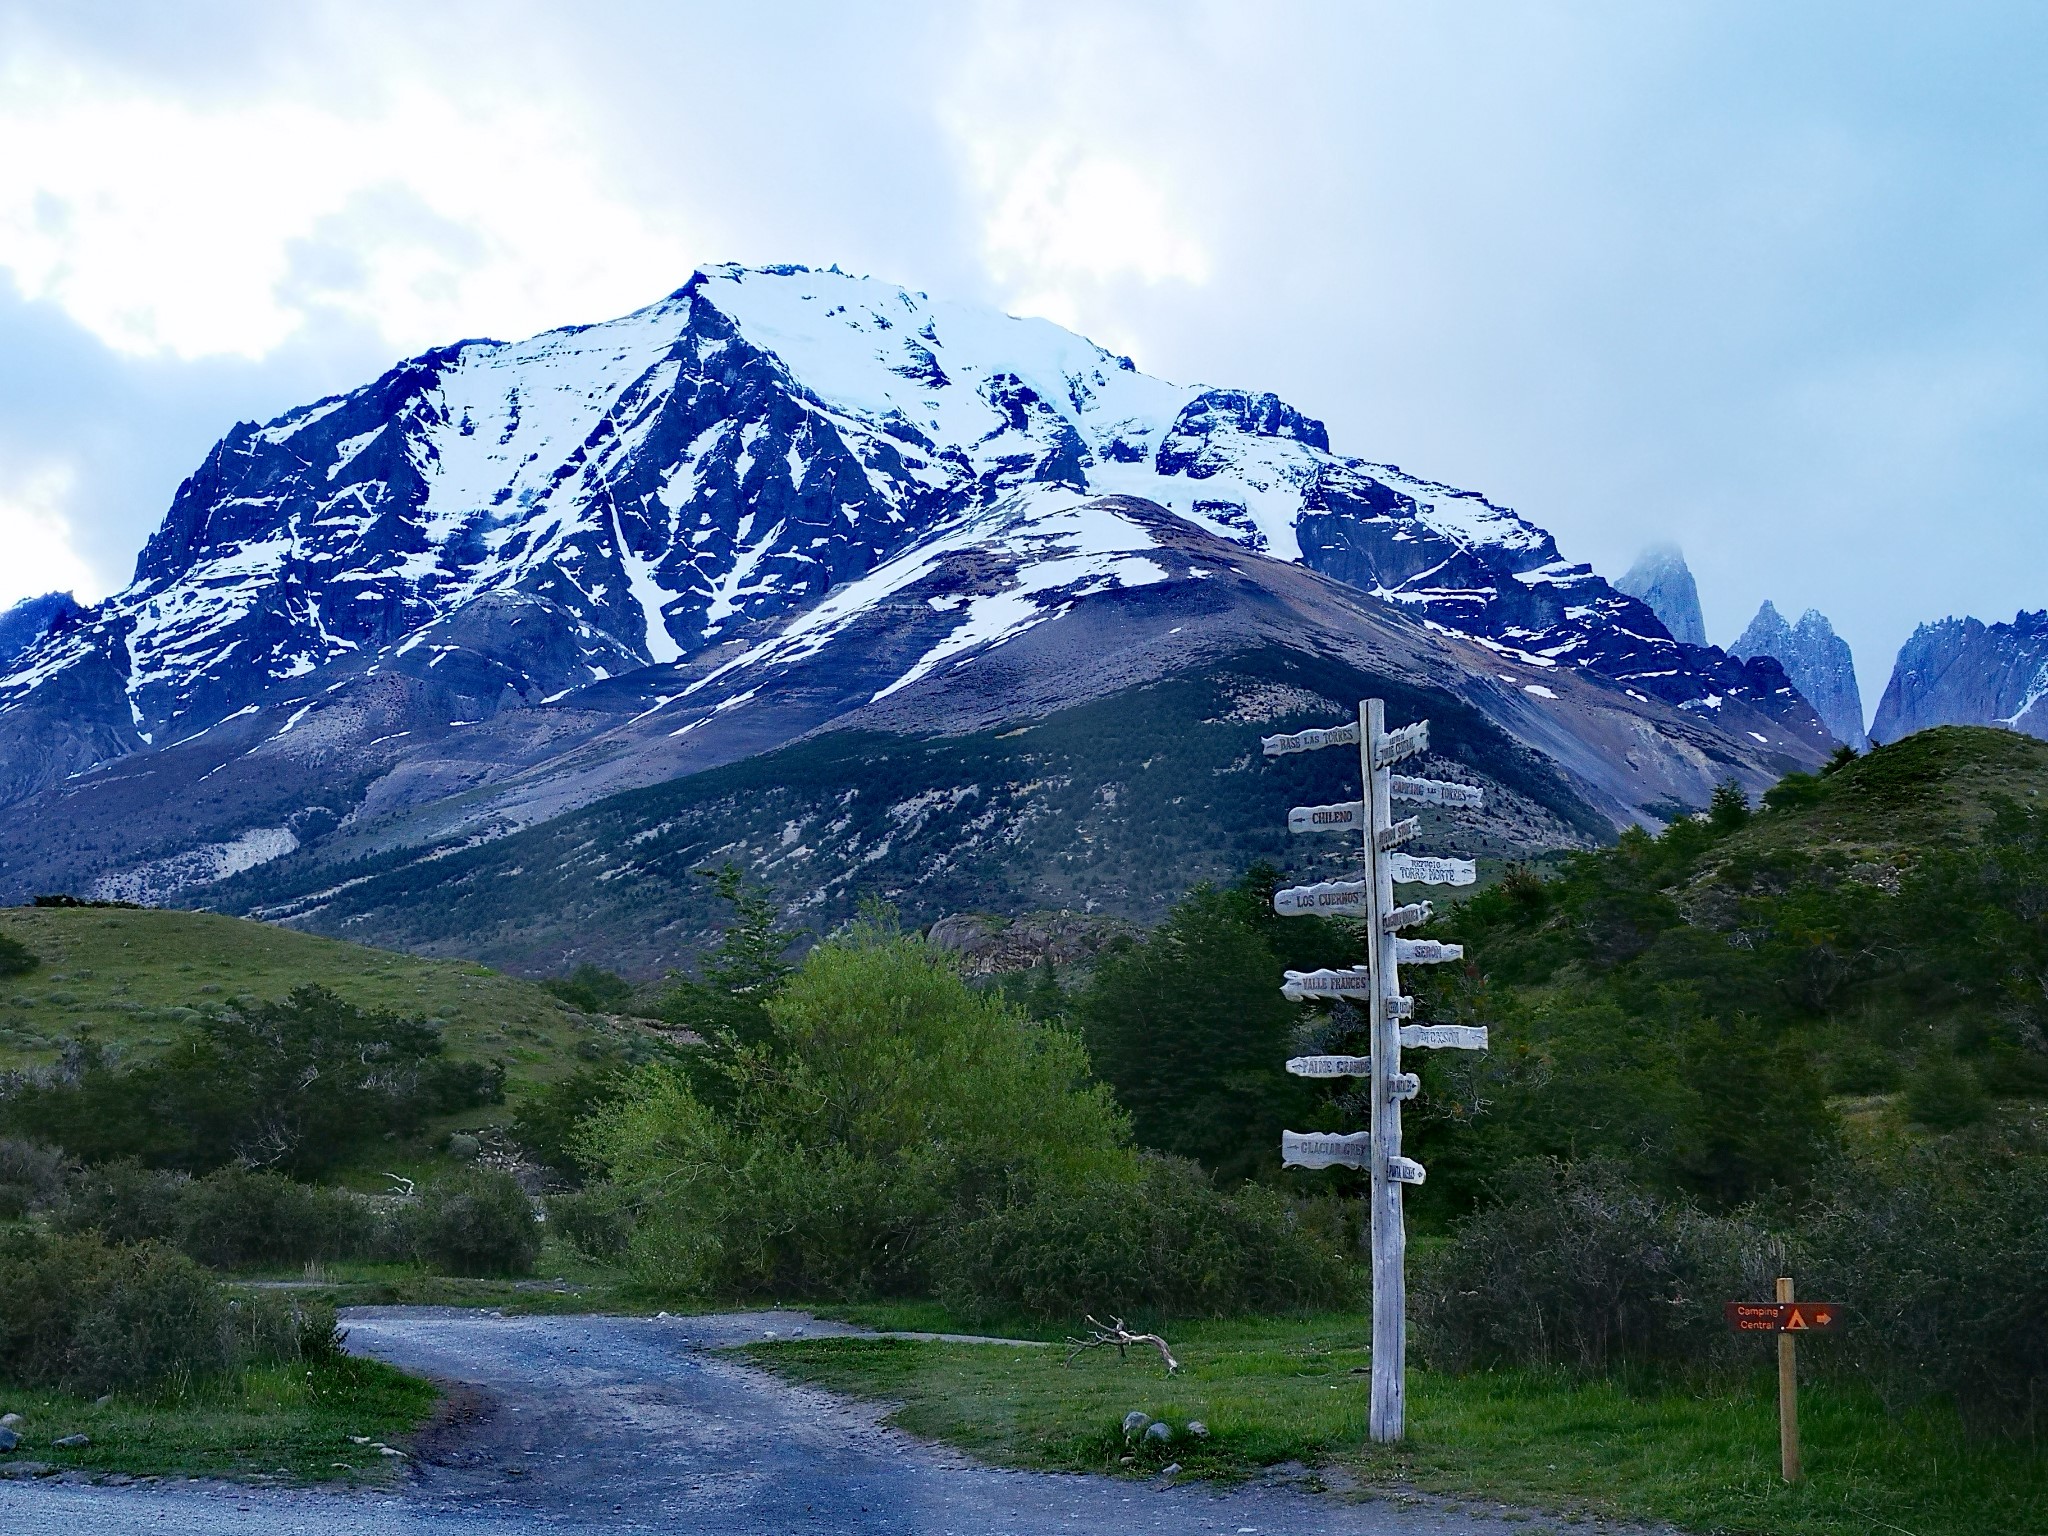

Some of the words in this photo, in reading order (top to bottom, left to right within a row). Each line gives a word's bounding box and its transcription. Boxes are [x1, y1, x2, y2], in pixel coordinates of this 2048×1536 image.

[1279, 736, 1301, 751] BASE
[1304, 735, 1320, 745] LAS
[1322, 728, 1353, 745] TORRES
[1392, 780, 1424, 796] CAMPING
[1441, 787, 1467, 801] TORRES
[1312, 810, 1353, 825] CHILENO
[1400, 867, 1426, 879] TORRE
[1429, 869, 1455, 881] NORTE
[1297, 895, 1315, 907] LOS
[1319, 892, 1359, 906] CUERNOS
[1303, 977, 1328, 990] VALLE
[1330, 976, 1366, 989] FRANCES
[1420, 1031, 1460, 1045] DICKSON
[1302, 1061, 1333, 1074] PAINE
[1337, 1061, 1371, 1074] GRANDE
[1301, 1143, 1342, 1155] GLACIAR
[1344, 1144, 1366, 1156] GREY
[1737, 1306, 1779, 1318] Camping
[1740, 1320, 1775, 1330] Central
